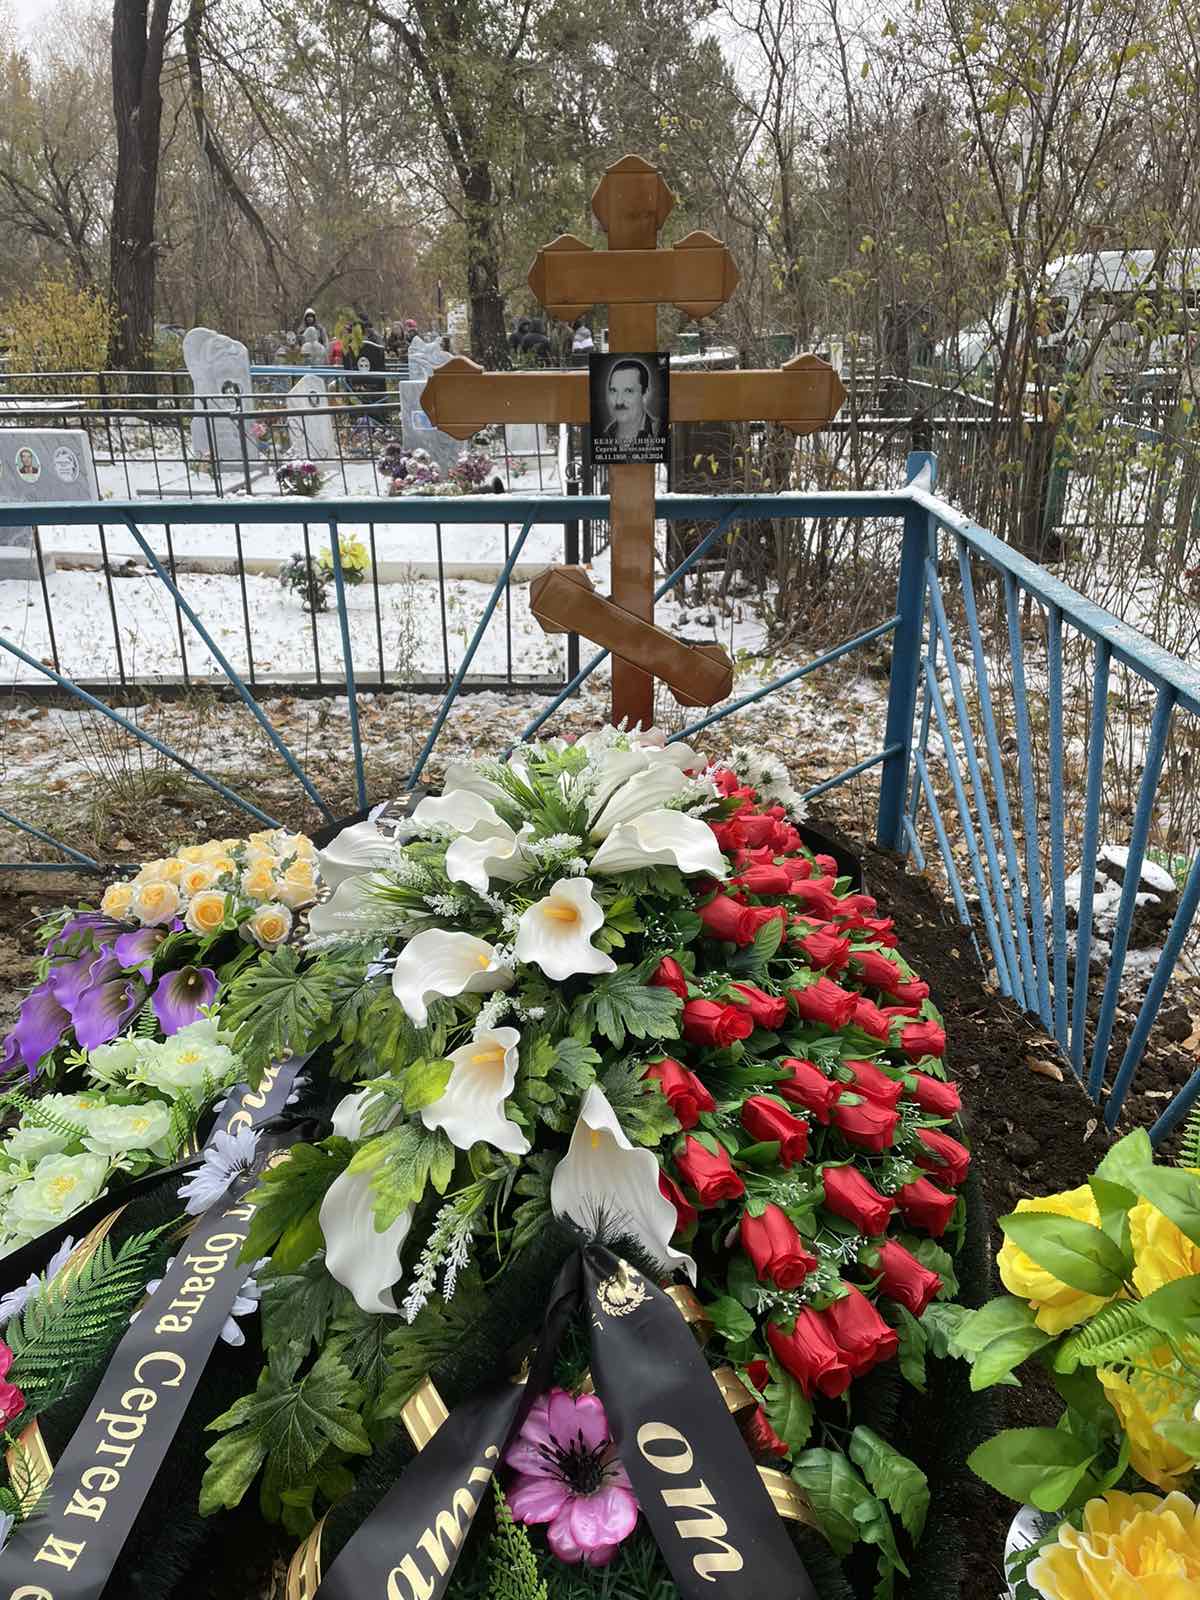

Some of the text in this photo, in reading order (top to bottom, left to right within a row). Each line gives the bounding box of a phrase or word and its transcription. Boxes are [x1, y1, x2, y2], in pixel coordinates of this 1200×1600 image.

[154, 1231, 248, 1335] брата
[63, 1350, 187, 1523] Сергея
[33, 1533, 88, 1573] и
